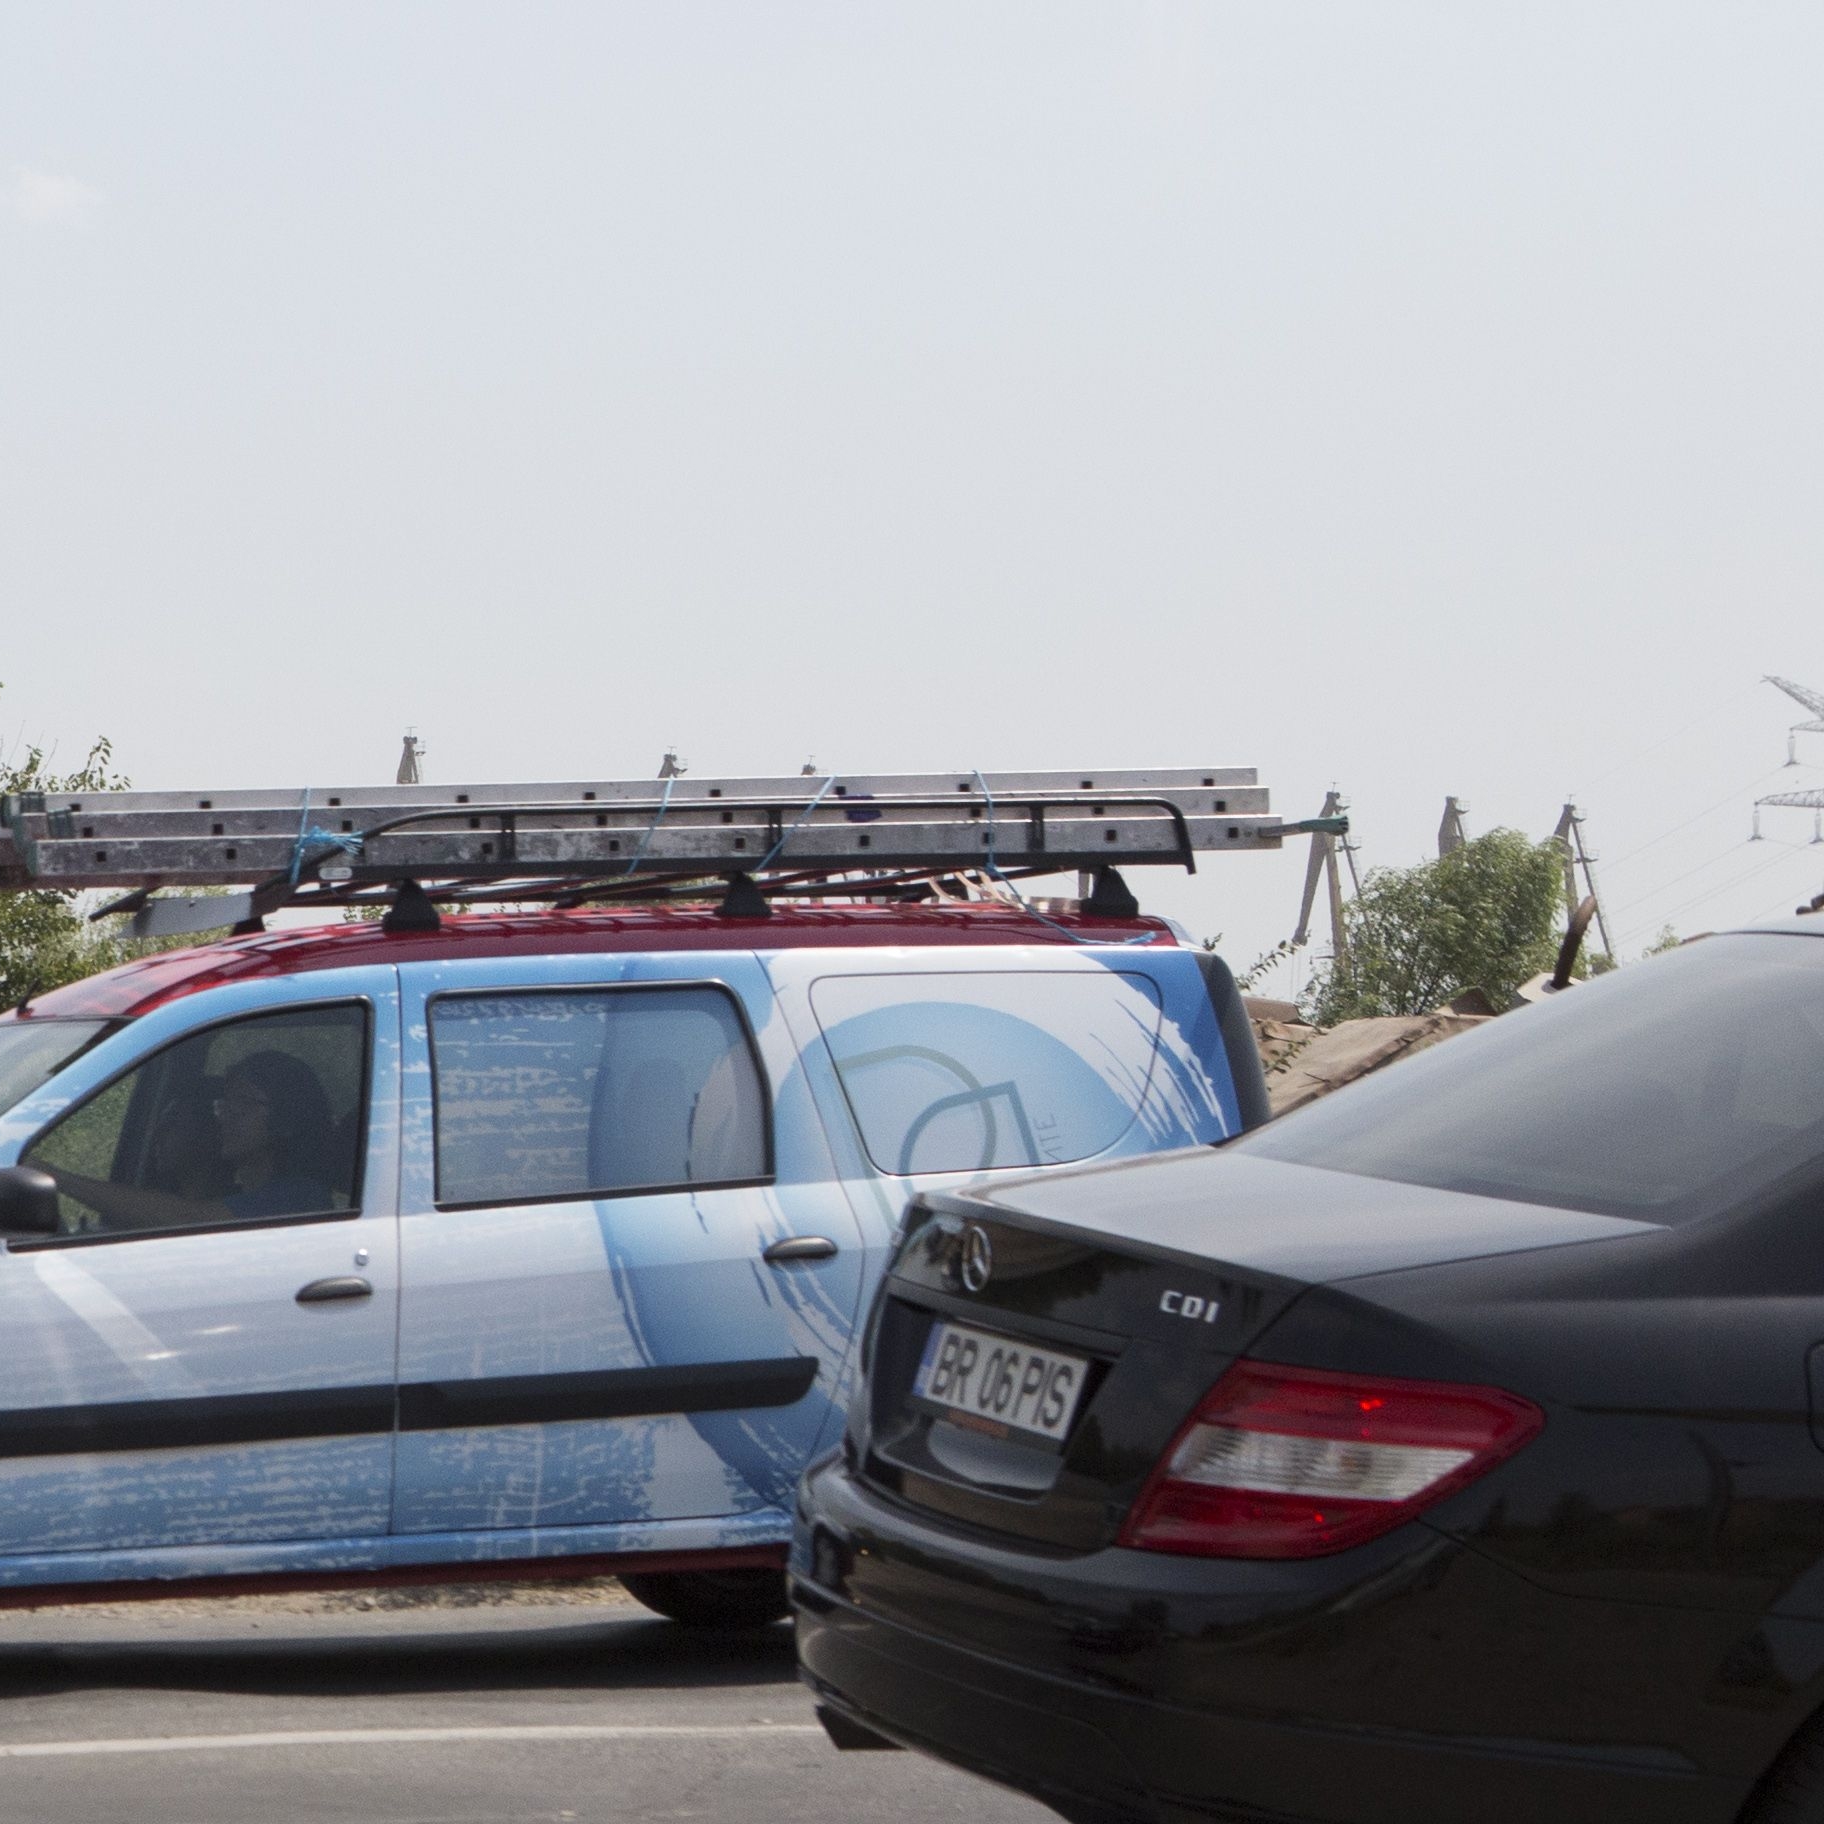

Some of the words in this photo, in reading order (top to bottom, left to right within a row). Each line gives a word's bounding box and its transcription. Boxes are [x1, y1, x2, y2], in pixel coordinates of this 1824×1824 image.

[1159, 1290, 1220, 1323] CDI
[931, 1333, 978, 1403] BR
[976, 1348, 1019, 1413] 06
[1011, 1355, 1073, 1428] PIS
